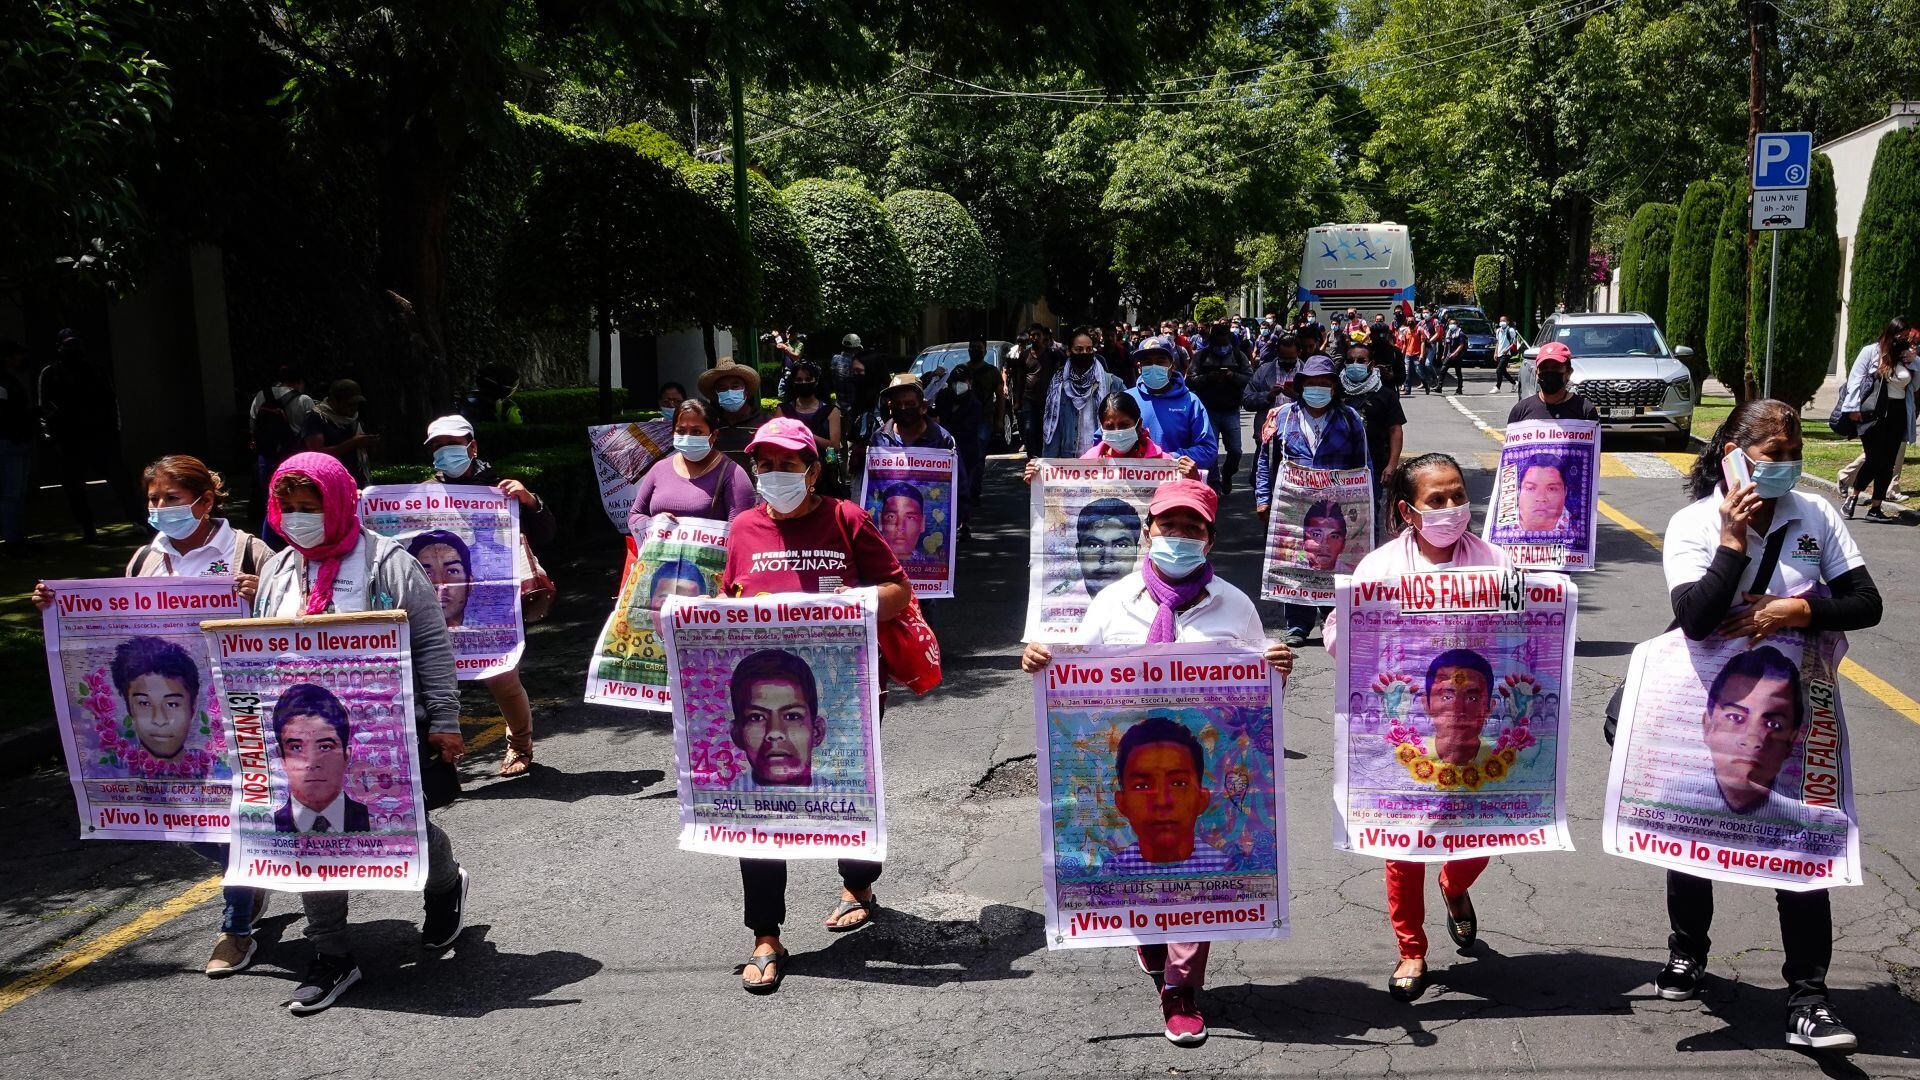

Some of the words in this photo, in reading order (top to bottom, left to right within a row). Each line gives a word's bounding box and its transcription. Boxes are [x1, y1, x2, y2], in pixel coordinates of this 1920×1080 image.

[1759, 138, 1790, 177] P
[1315, 280, 1337, 289] 2061
[1522, 432, 1533, 440] se
[1536, 429, 1546, 439] lo
[1549, 428, 1594, 441] llevaron!
[882, 458, 893, 467] se
[896, 457, 904, 467] lo
[907, 457, 951, 469] llevaron!
[1045, 467, 1081, 482] ¡Vivo
[1084, 468, 1098, 480] se
[1102, 467, 1115, 480] lo
[1118, 467, 1178, 481] llevaron!
[364, 498, 400, 515] ¡Vivo
[405, 499, 422, 510] se
[426, 496, 440, 509] lo
[444, 497, 508, 510] llevaron!
[657, 528, 672, 540] se
[677, 529, 688, 541] lo
[752, 552, 761, 560] NI
[813, 550, 845, 560] OLVIDO
[1520, 546, 1551, 564] FALTAN
[749, 558, 847, 574] AYOTZINAPA
[1273, 585, 1296, 596] ¡Vivo
[1300, 588, 1309, 597] lo
[1401, 575, 1434, 609] NOS
[1440, 572, 1499, 609] FALTAN
[58, 591, 103, 617] ¡Vivo
[109, 594, 129, 611] se
[135, 592, 151, 610] lo
[157, 591, 238, 610] llevaron!
[675, 605, 721, 628] ¡Vivo
[726, 608, 749, 624] se
[754, 604, 771, 623] lo
[777, 602, 862, 622] llevaron!
[222, 634, 263, 657] ¡Vivo
[268, 637, 289, 651] se
[295, 633, 312, 650] lo
[317, 630, 397, 650] llevaron!
[1050, 664, 1103, 689] ¡Vivo
[1110, 667, 1136, 683] se
[1143, 661, 1163, 682] lo
[1170, 659, 1266, 682] llevaron!
[603, 681, 637, 697] ¡Vivo
[642, 686, 654, 698] lo
[1054, 699, 1064, 707] Yo,
[1141, 697, 1171, 706] Escocia,
[234, 715, 267, 769] FALTAN
[1807, 706, 1837, 769] FALTAN
[692, 749, 737, 782] 43
[100, 784, 129, 793] JORGE
[171, 786, 195, 795] CRUZ
[243, 773, 269, 804] NOS
[1804, 772, 1838, 809] NOS
[713, 797, 745, 811] SAÚL
[754, 799, 796, 813] BRUNO
[805, 798, 856, 813] GARCÍA
[1378, 799, 1430, 810] Marcial
[100, 808, 140, 827] ¡Vivo
[144, 809, 159, 825] lo
[1352, 811, 1370, 819] Hijo
[1632, 807, 1665, 821] JESÚS
[1672, 813, 1713, 828] JOVANY
[1719, 820, 1781, 838] RODRÍGUEZ
[1785, 828, 1836, 844] TLATEMPA
[272, 838, 300, 849] JORGE
[357, 838, 383, 848] NAVA
[703, 825, 746, 844] ¡Vivo
[752, 827, 767, 843] lo
[773, 830, 867, 849] queremos!
[1359, 828, 1411, 848] ¡Vivo
[1417, 830, 1436, 848] lo
[1443, 829, 1546, 852] queremos!
[1629, 832, 1682, 857] ¡Vivo
[1690, 840, 1710, 861] lo
[1717, 849, 1833, 877] queremos!
[248, 859, 291, 877] ¡Vivo
[295, 861, 312, 877] lo
[318, 861, 409, 881] queremos!
[1087, 881, 1115, 896] JOSÉ
[1162, 882, 1192, 893] LUNA
[1199, 880, 1245, 891] TORRES
[1064, 901, 1082, 909] Hijo
[1070, 912, 1122, 937] ¡Vivo
[1129, 910, 1148, 928] lo
[1155, 904, 1265, 931] queremos!
